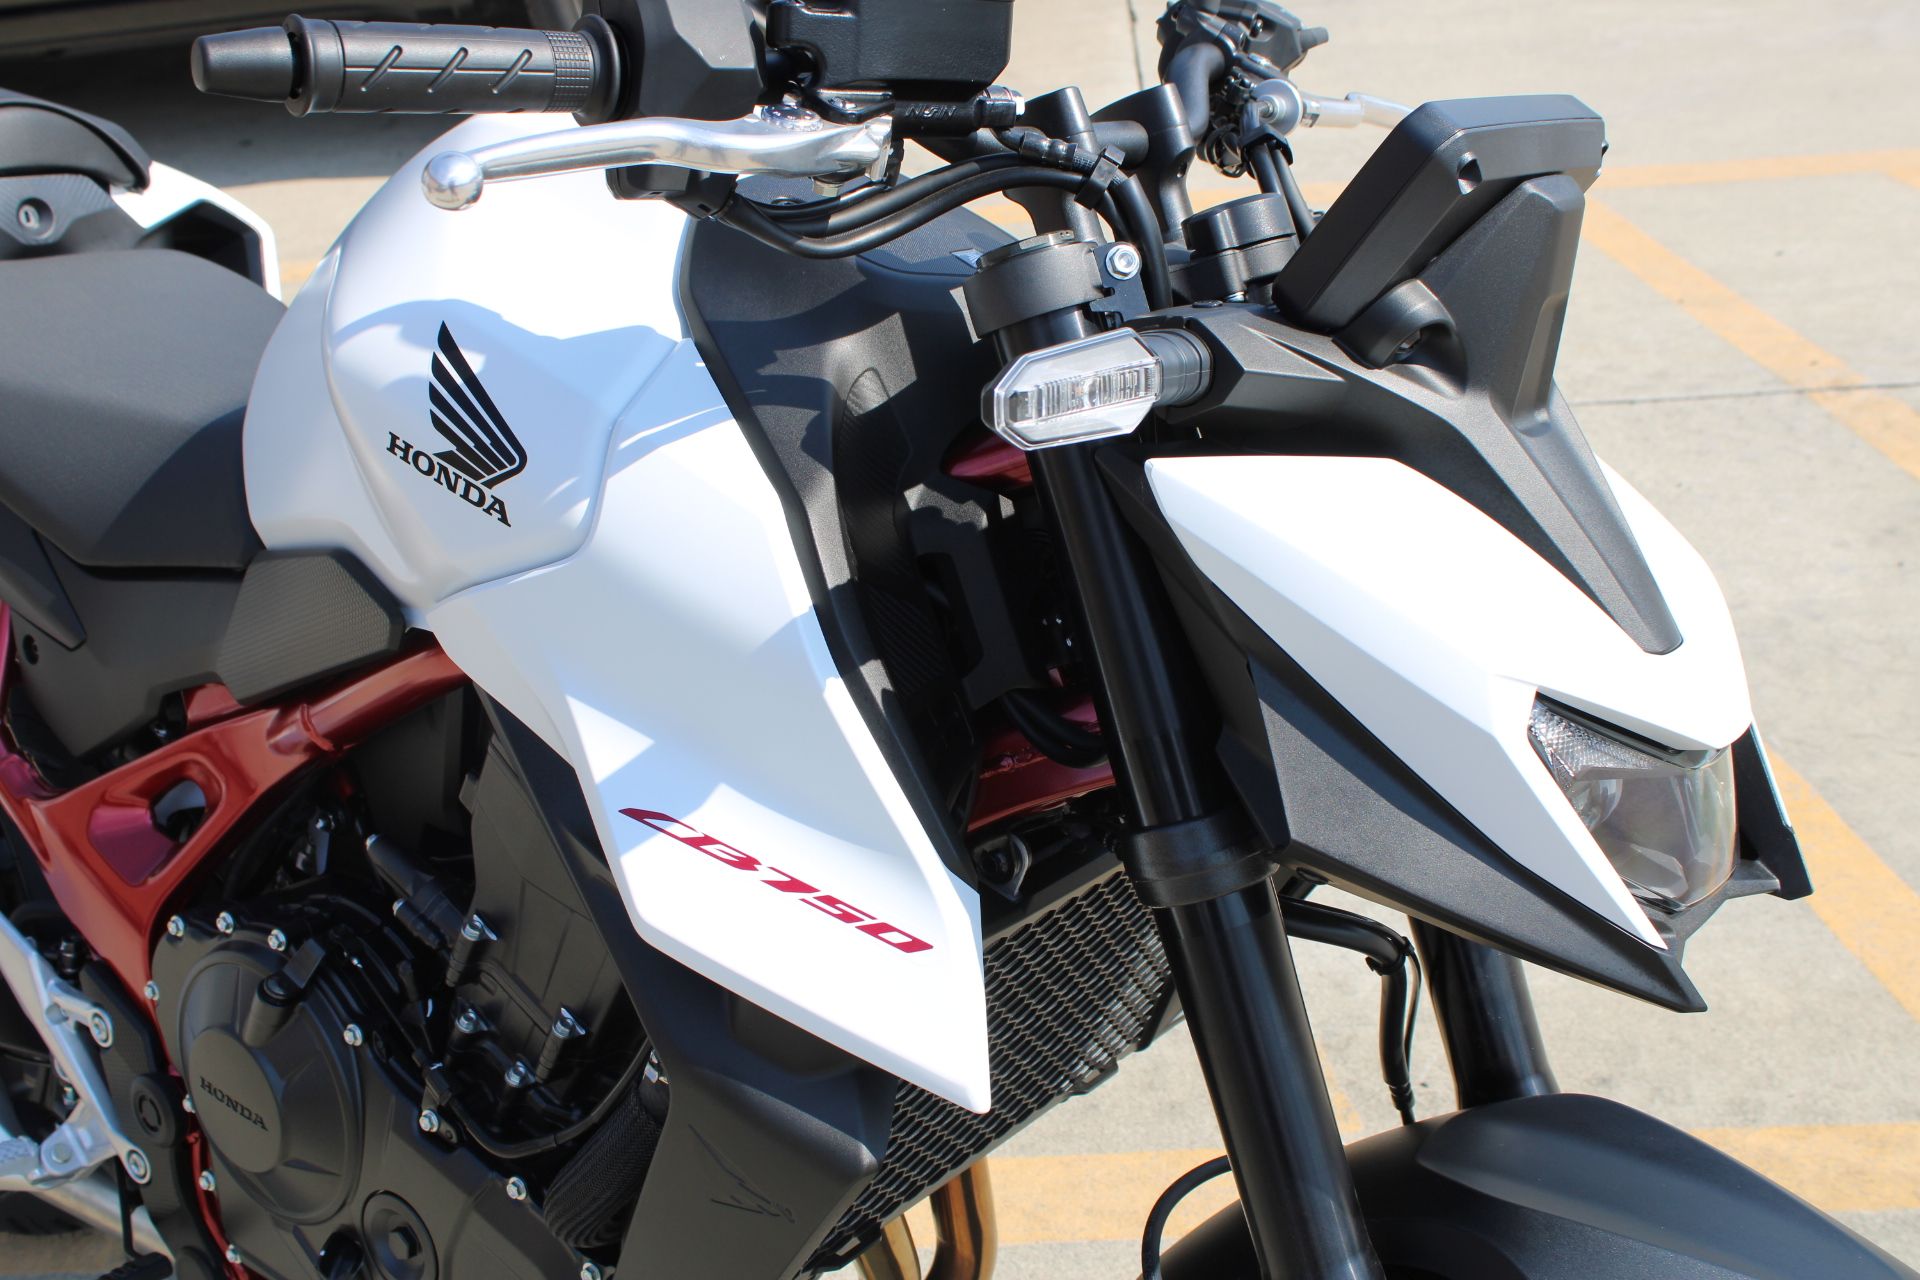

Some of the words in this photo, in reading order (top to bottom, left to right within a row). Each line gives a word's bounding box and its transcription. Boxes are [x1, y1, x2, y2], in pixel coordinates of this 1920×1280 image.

[386, 431, 511, 527] HONDA
[618, 807, 934, 953] CB750
[200, 1075, 268, 1131] HONDA
